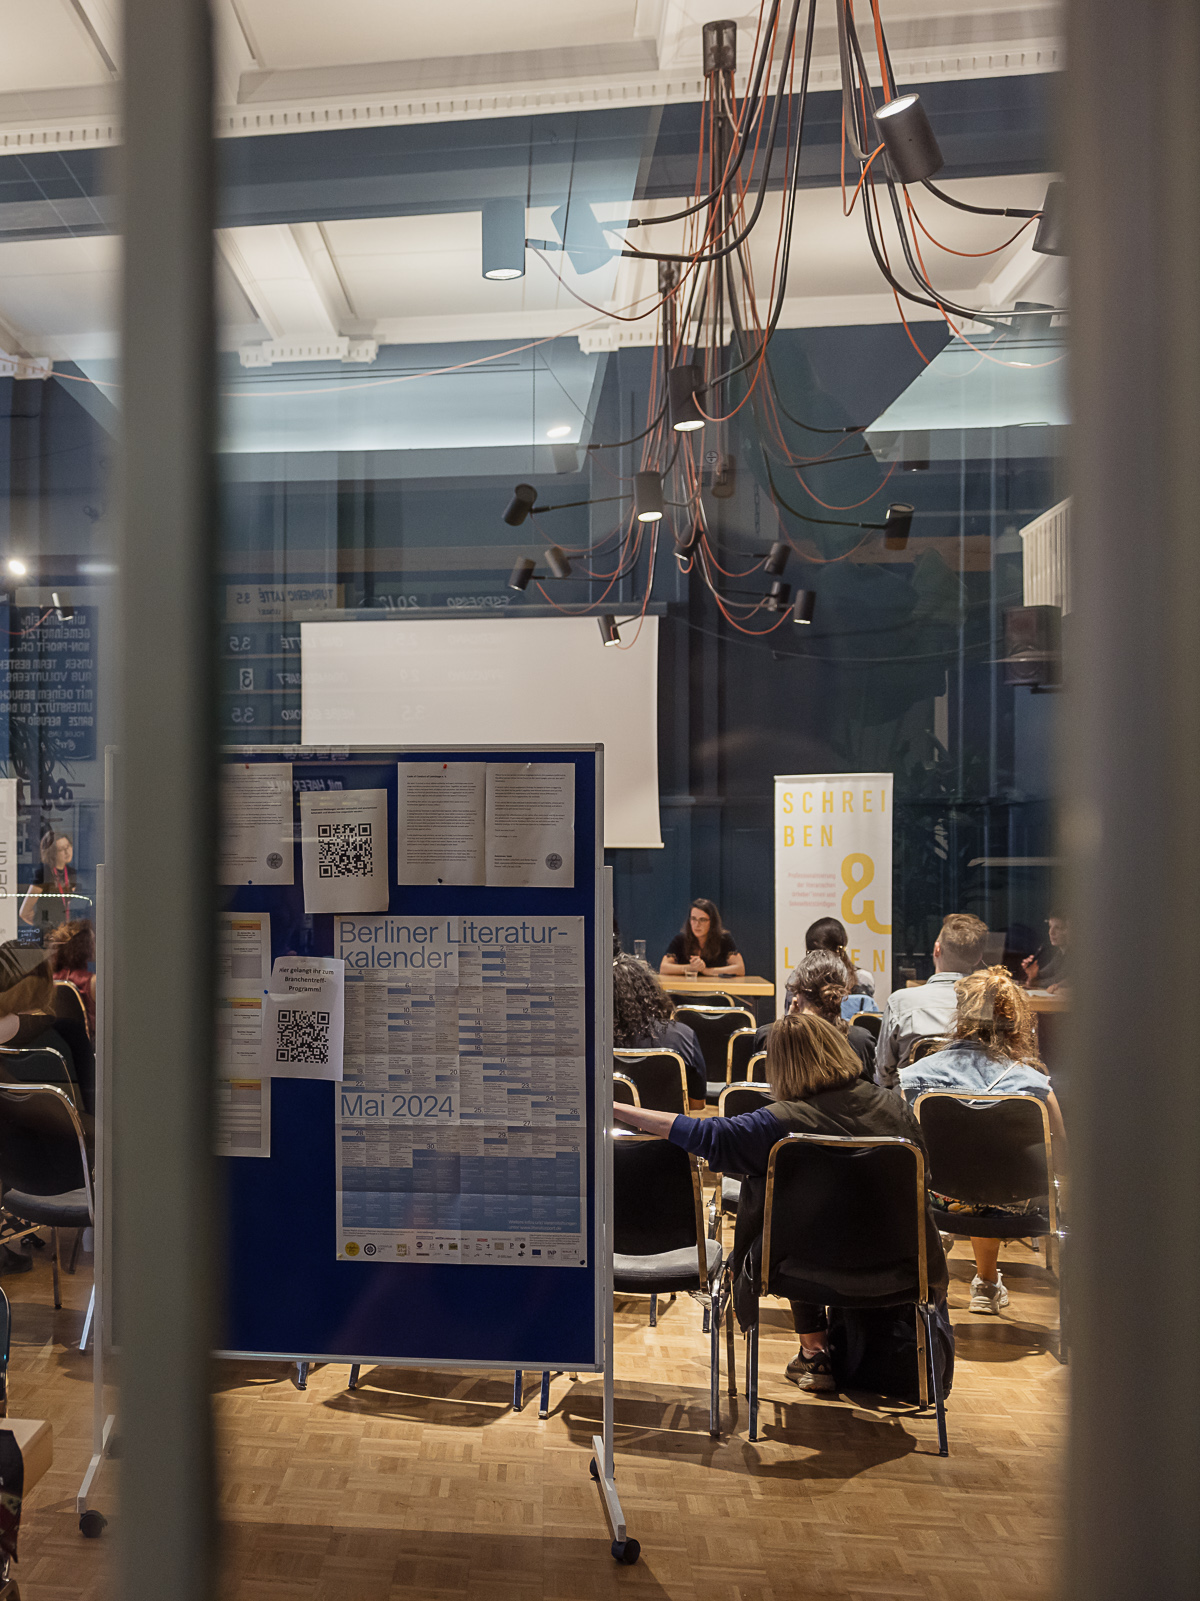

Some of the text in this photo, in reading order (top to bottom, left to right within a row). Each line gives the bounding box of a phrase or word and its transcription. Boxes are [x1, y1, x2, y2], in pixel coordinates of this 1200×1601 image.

[783, 790, 885, 814] SCHREI
[784, 825, 833, 847] BEN
[340, 920, 568, 944] Berliner Literatur-
[340, 946, 453, 968] kalender
[784, 947, 885, 973] LEN
[290, 967, 312, 975] gelangt
[341, 1094, 385, 1116] Mai
[392, 1095, 454, 1118] 2024
